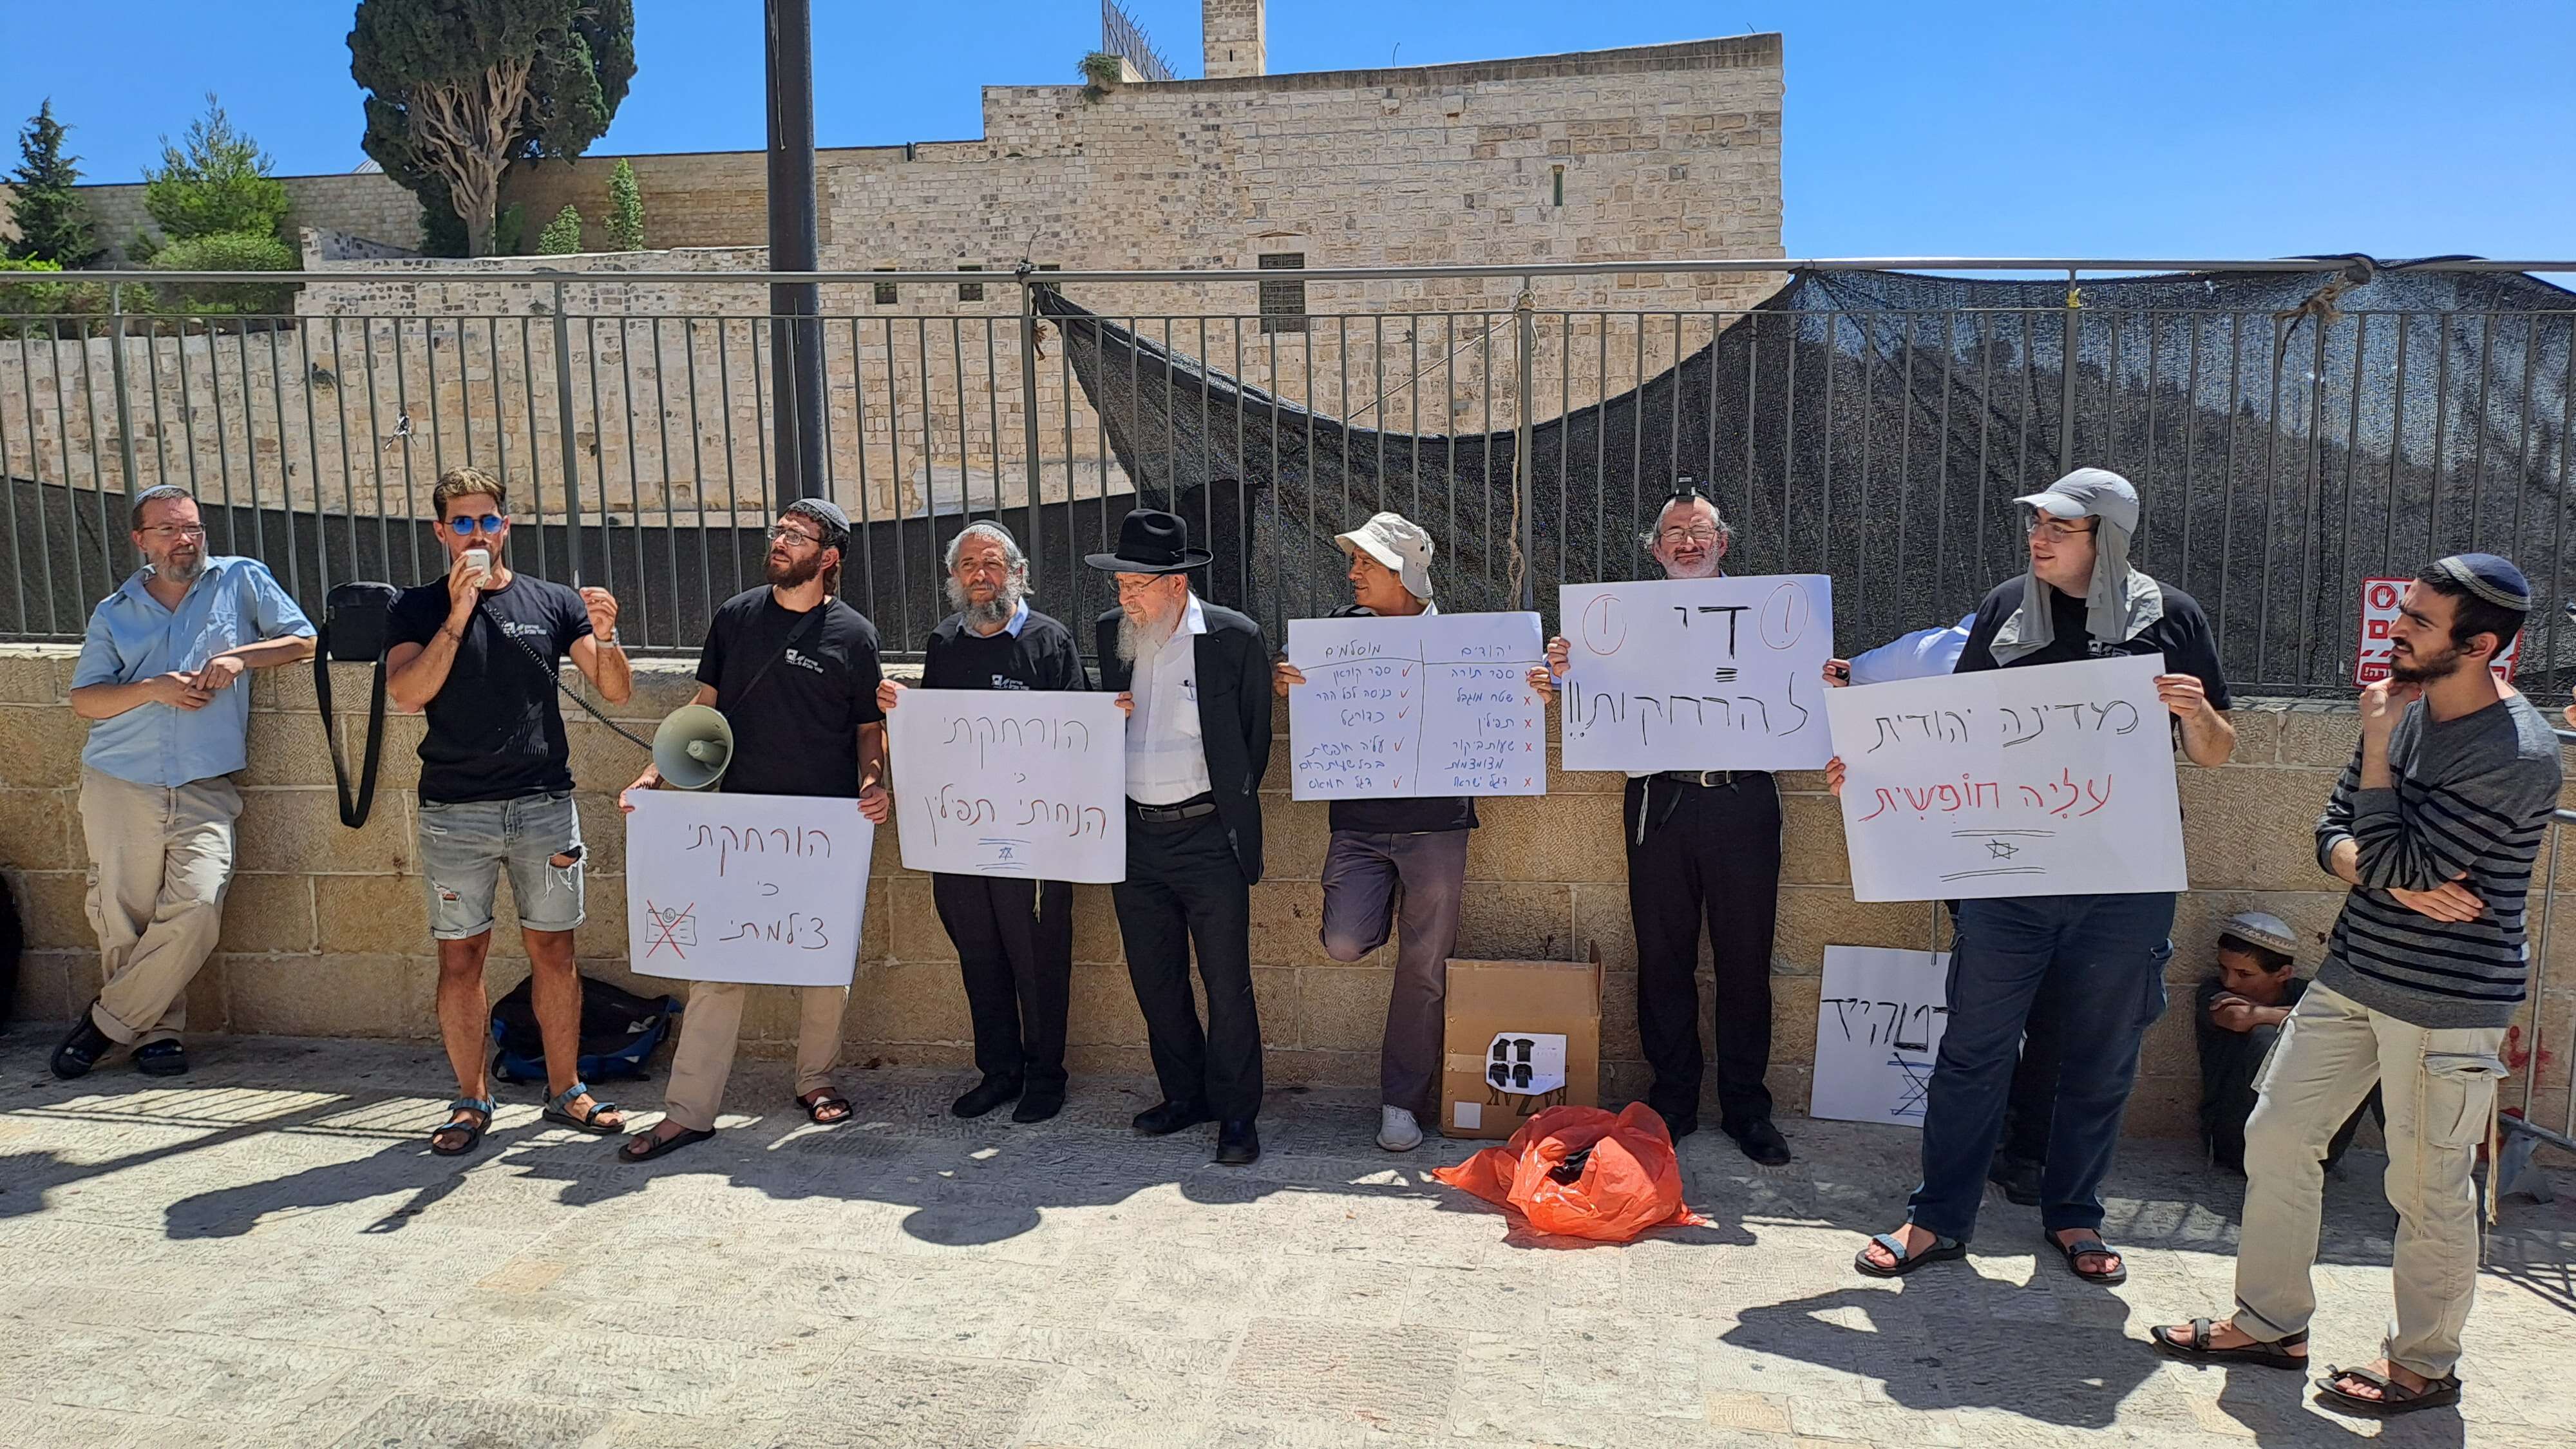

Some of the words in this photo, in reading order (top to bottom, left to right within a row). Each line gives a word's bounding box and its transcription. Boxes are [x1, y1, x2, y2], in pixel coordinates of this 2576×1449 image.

[1673, 605, 1752, 660] די
[1325, 639, 1381, 659] מוסלמים
[1461, 644, 1511, 658] יהודים
[1332, 666, 1362, 687] קוראן
[1367, 665, 1392, 677] ספר
[1451, 666, 1482, 679] תורה
[1489, 669, 1515, 679] ספר
[1316, 690, 1337, 701] ההר
[1341, 685, 1358, 700] לכל
[1363, 688, 1392, 700] כניסה
[1457, 687, 1483, 706] מוגבל
[1490, 690, 1513, 703] שטח
[1340, 708, 1385, 727] כדורגל
[1478, 712, 1515, 737] תפילין
[2000, 700, 2139, 748] מדינה
[1866, 708, 1971, 754] יהודית
[943, 716, 1088, 770] הורחקתי
[1359, 734, 1385, 754] עליה
[1452, 739, 1484, 757] ביקור
[1484, 739, 1515, 754] שעות
[1325, 759, 1356, 773] שעות
[1358, 758, 1385, 770] בכל
[1444, 756, 1504, 770] מצומצמות
[1014, 772, 1026, 784] כי
[1309, 777, 1345, 789] חמאס
[1354, 775, 1372, 790] דגל
[1489, 773, 1508, 790] דגל
[924, 783, 996, 848] תפילין
[1016, 799, 1106, 840] הנחתי
[685, 824, 831, 878] הורחקתי
[757, 880, 779, 896] כי
[719, 912, 829, 950] צילמתי
